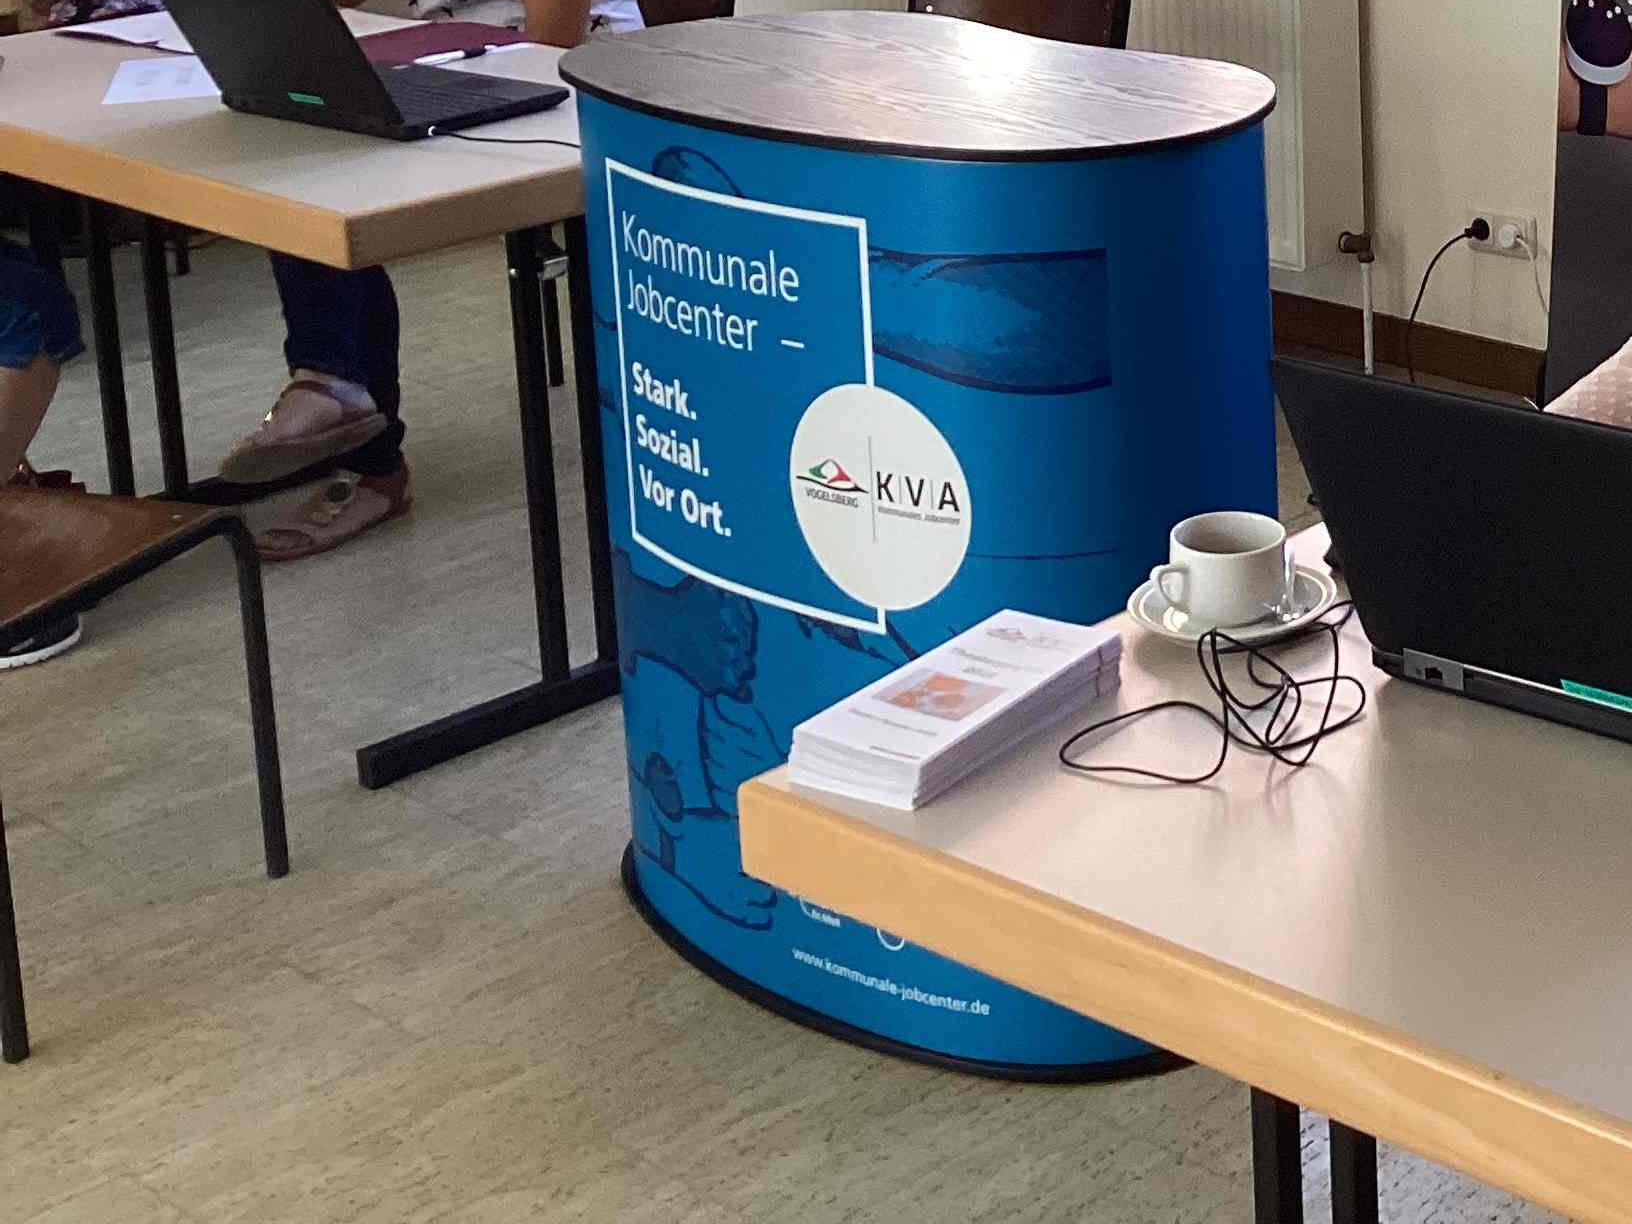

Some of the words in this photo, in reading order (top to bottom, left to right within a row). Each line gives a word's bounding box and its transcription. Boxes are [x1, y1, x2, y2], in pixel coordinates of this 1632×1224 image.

[622, 210, 800, 302] Kommunale
[627, 269, 758, 352] Jobcenter
[632, 361, 697, 420] Stark.
[636, 414, 709, 477] Sozial.
[639, 463, 675, 512] Vor
[680, 488, 732, 537] Ort.
[805, 487, 859, 508] VOGELSBERG
[791, 947, 991, 1015] www.kommunale-jobcenter.de
